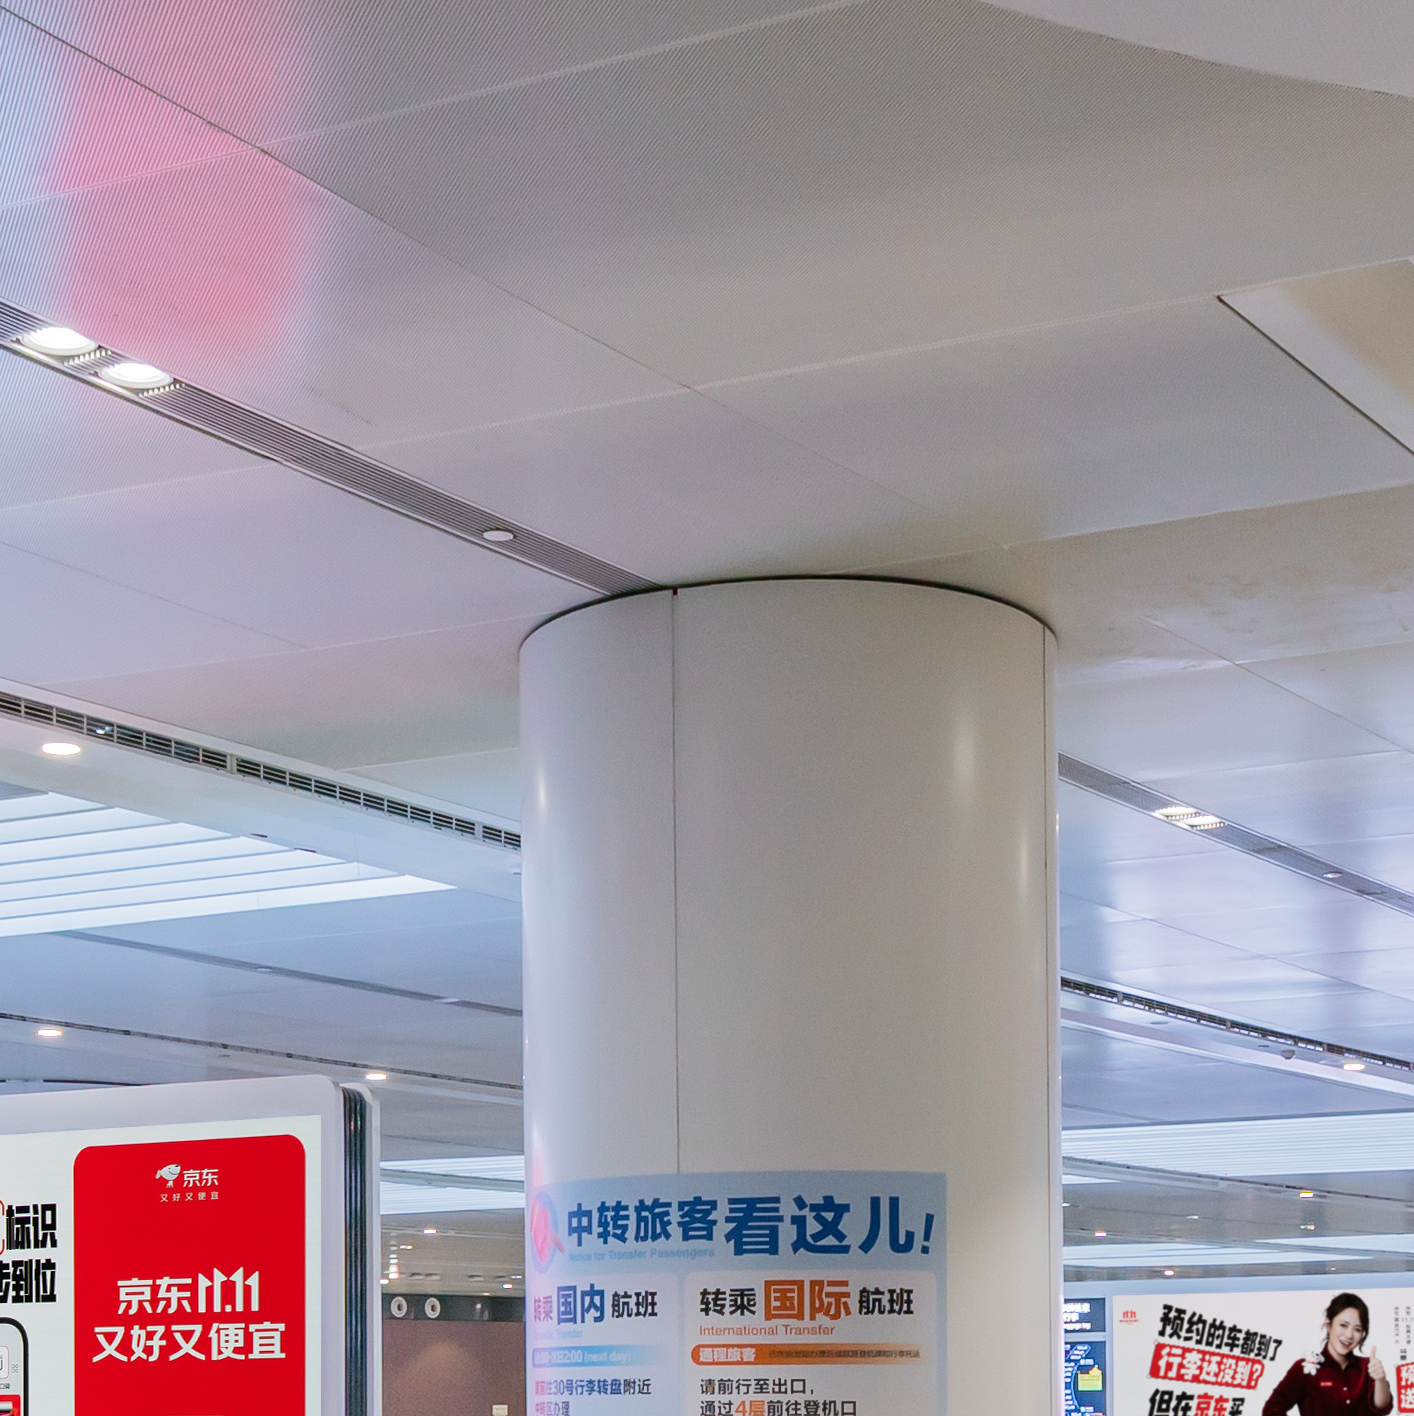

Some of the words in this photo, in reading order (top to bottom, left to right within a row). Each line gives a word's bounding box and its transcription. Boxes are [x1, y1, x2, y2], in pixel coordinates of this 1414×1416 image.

[183, 1168, 219, 1187] 京东
[160, 1191, 219, 1203] 又好又便宜
[650, 1248, 715, 1260] Passengers
[699, 1325, 778, 1336] International
[782, 1324, 836, 1336] Transfer
[1158, 1304, 1283, 1361] 预约的车都到了
[92, 1321, 286, 1363] 又好又便宜
[1157, 1345, 1260, 1387] 行李还没到?
[700, 1400, 857, 1416] 通过4层前往登机口
